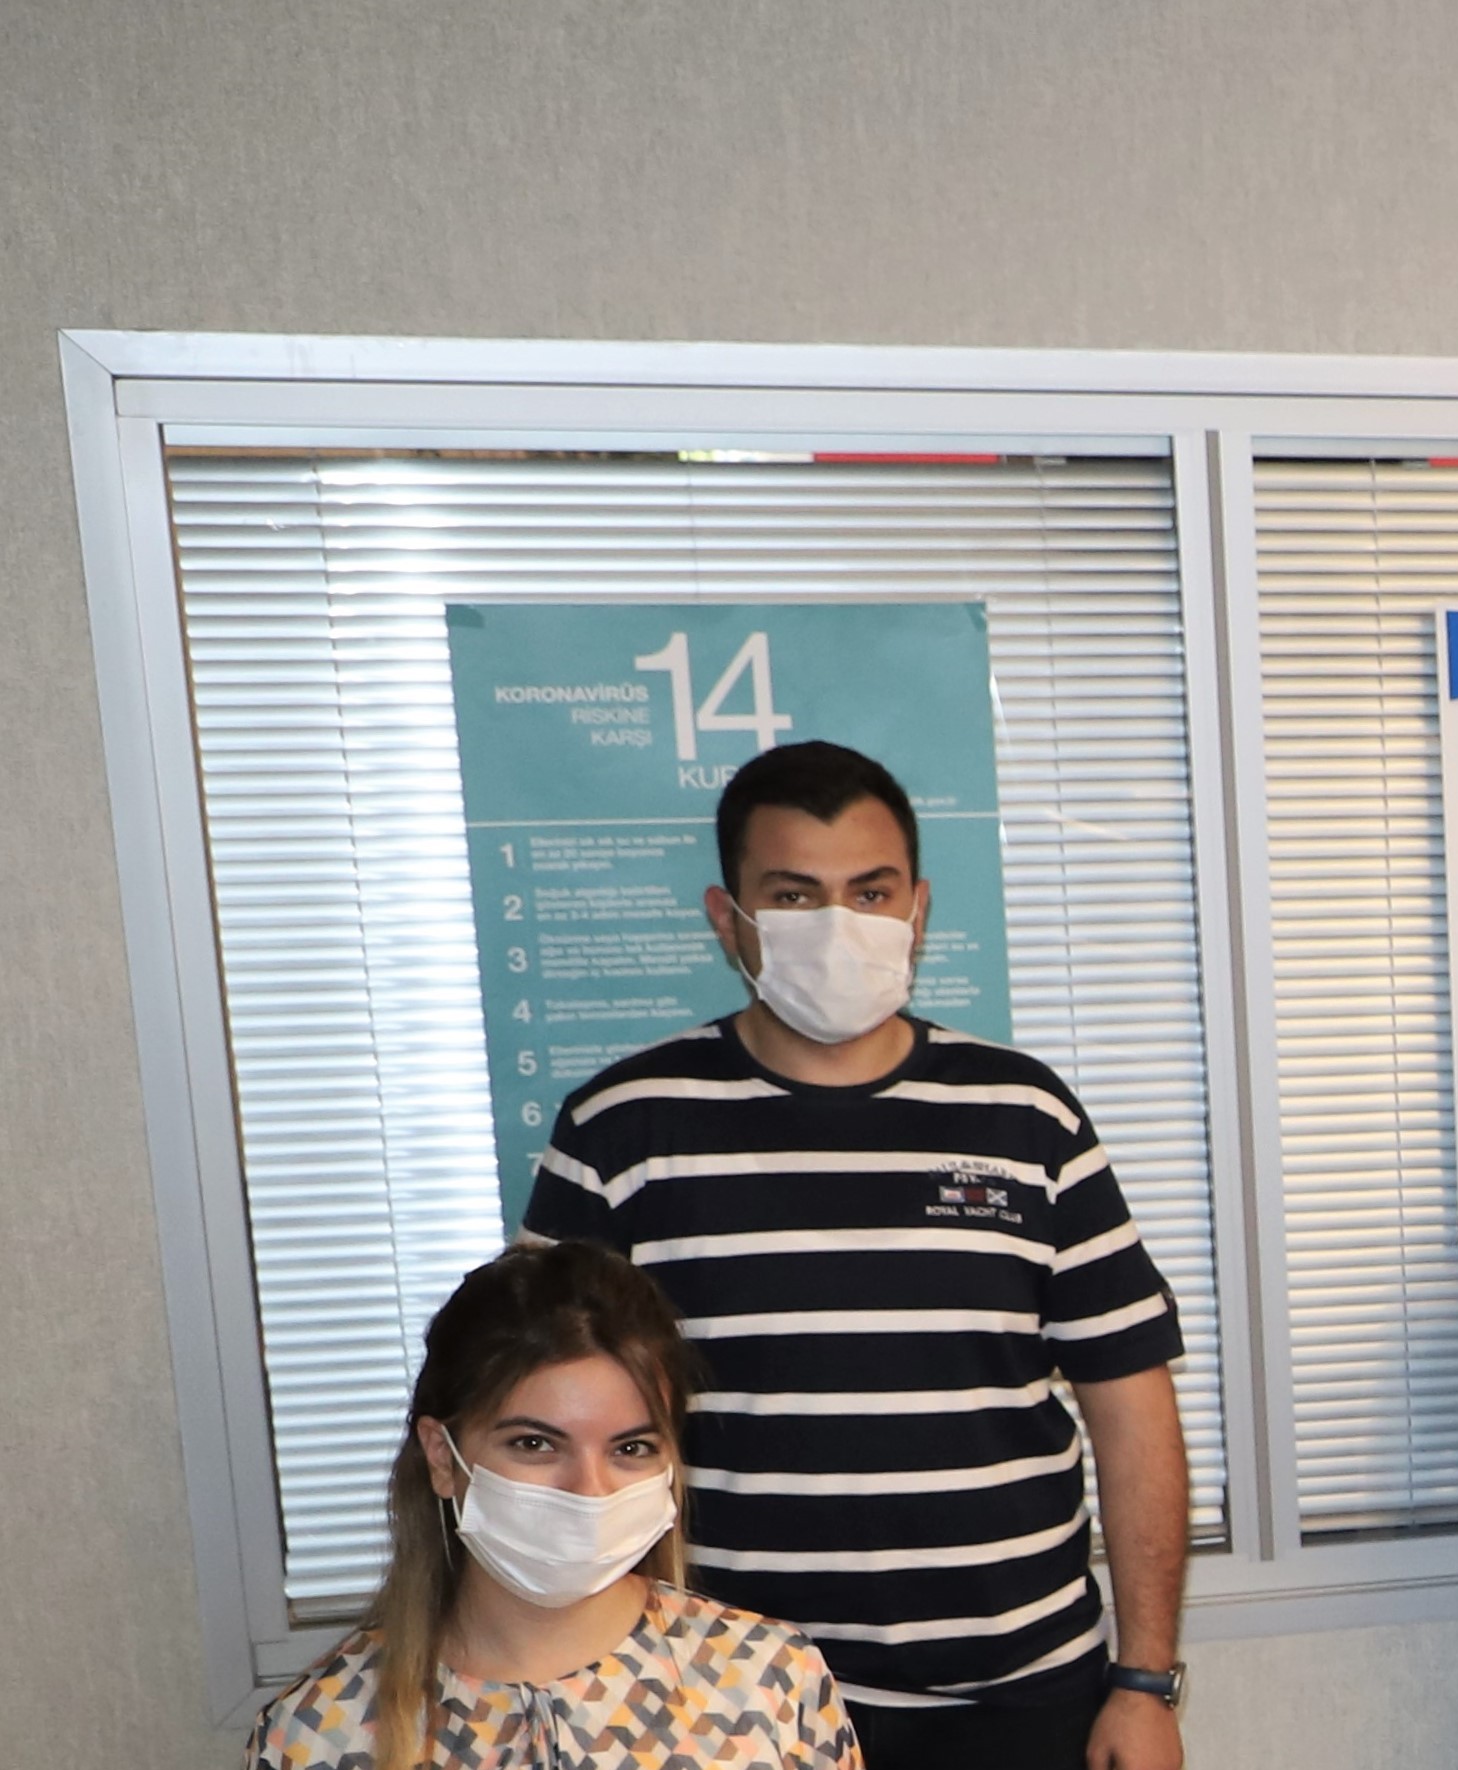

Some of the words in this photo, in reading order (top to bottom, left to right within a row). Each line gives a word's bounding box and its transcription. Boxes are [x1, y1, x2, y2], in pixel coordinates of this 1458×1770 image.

[495, 682, 648, 704] KORONAVİRÜS
[634, 632, 793, 761] 14
[591, 730, 652, 748] KARŞI
[501, 842, 515, 868] 1
[504, 894, 524, 922] 2
[507, 946, 529, 973] 3
[512, 999, 532, 1024] 4
[517, 1051, 538, 1076] 5
[521, 1102, 542, 1126] 6
